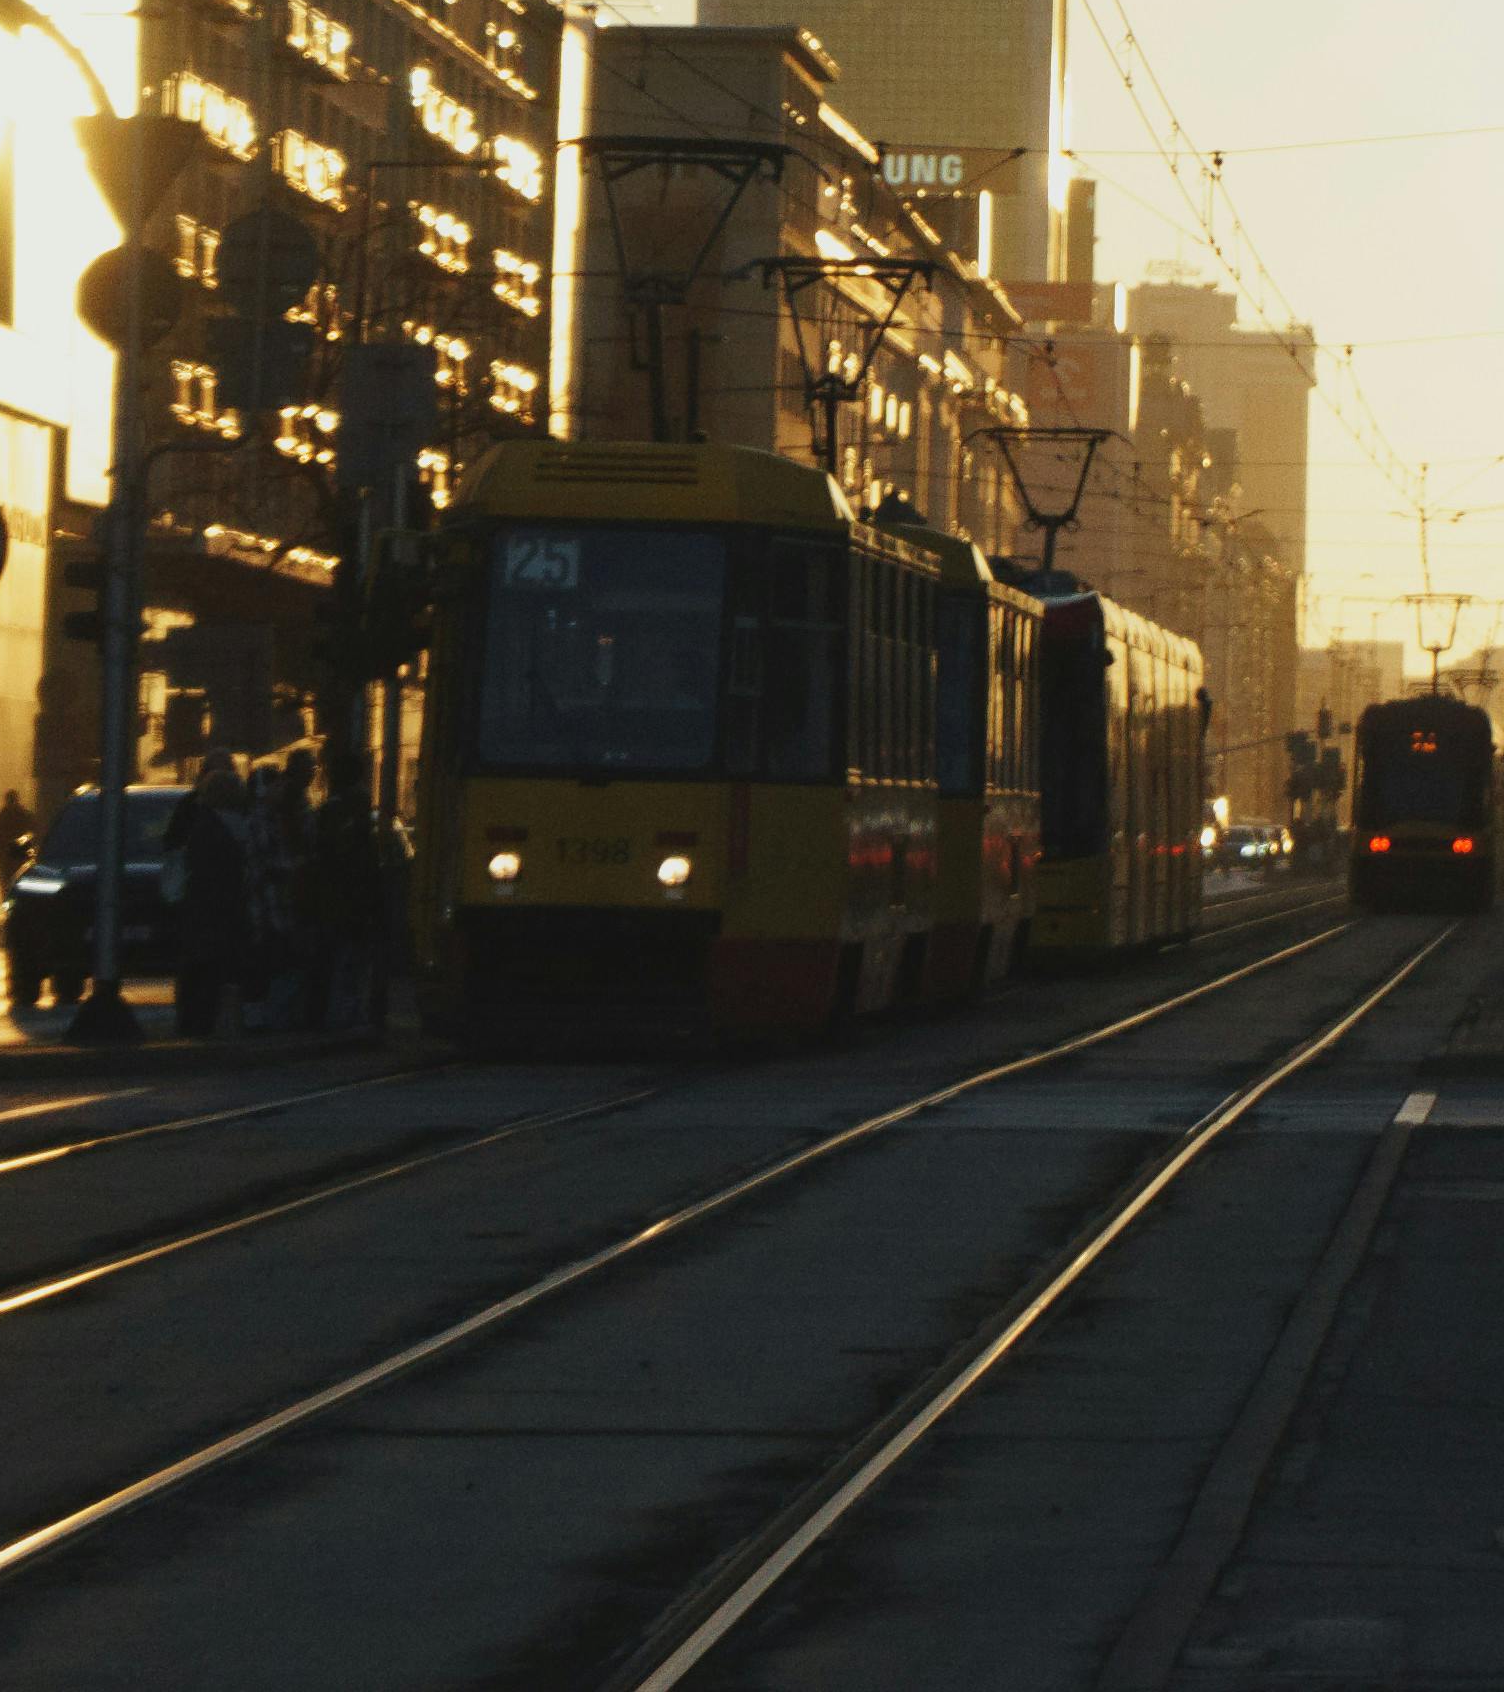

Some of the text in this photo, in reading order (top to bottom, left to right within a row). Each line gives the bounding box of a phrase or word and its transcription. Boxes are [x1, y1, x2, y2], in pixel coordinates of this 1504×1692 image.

[872, 154, 963, 185] UNG
[510, 537, 571, 583] 25
[556, 836, 631, 865] 1398
